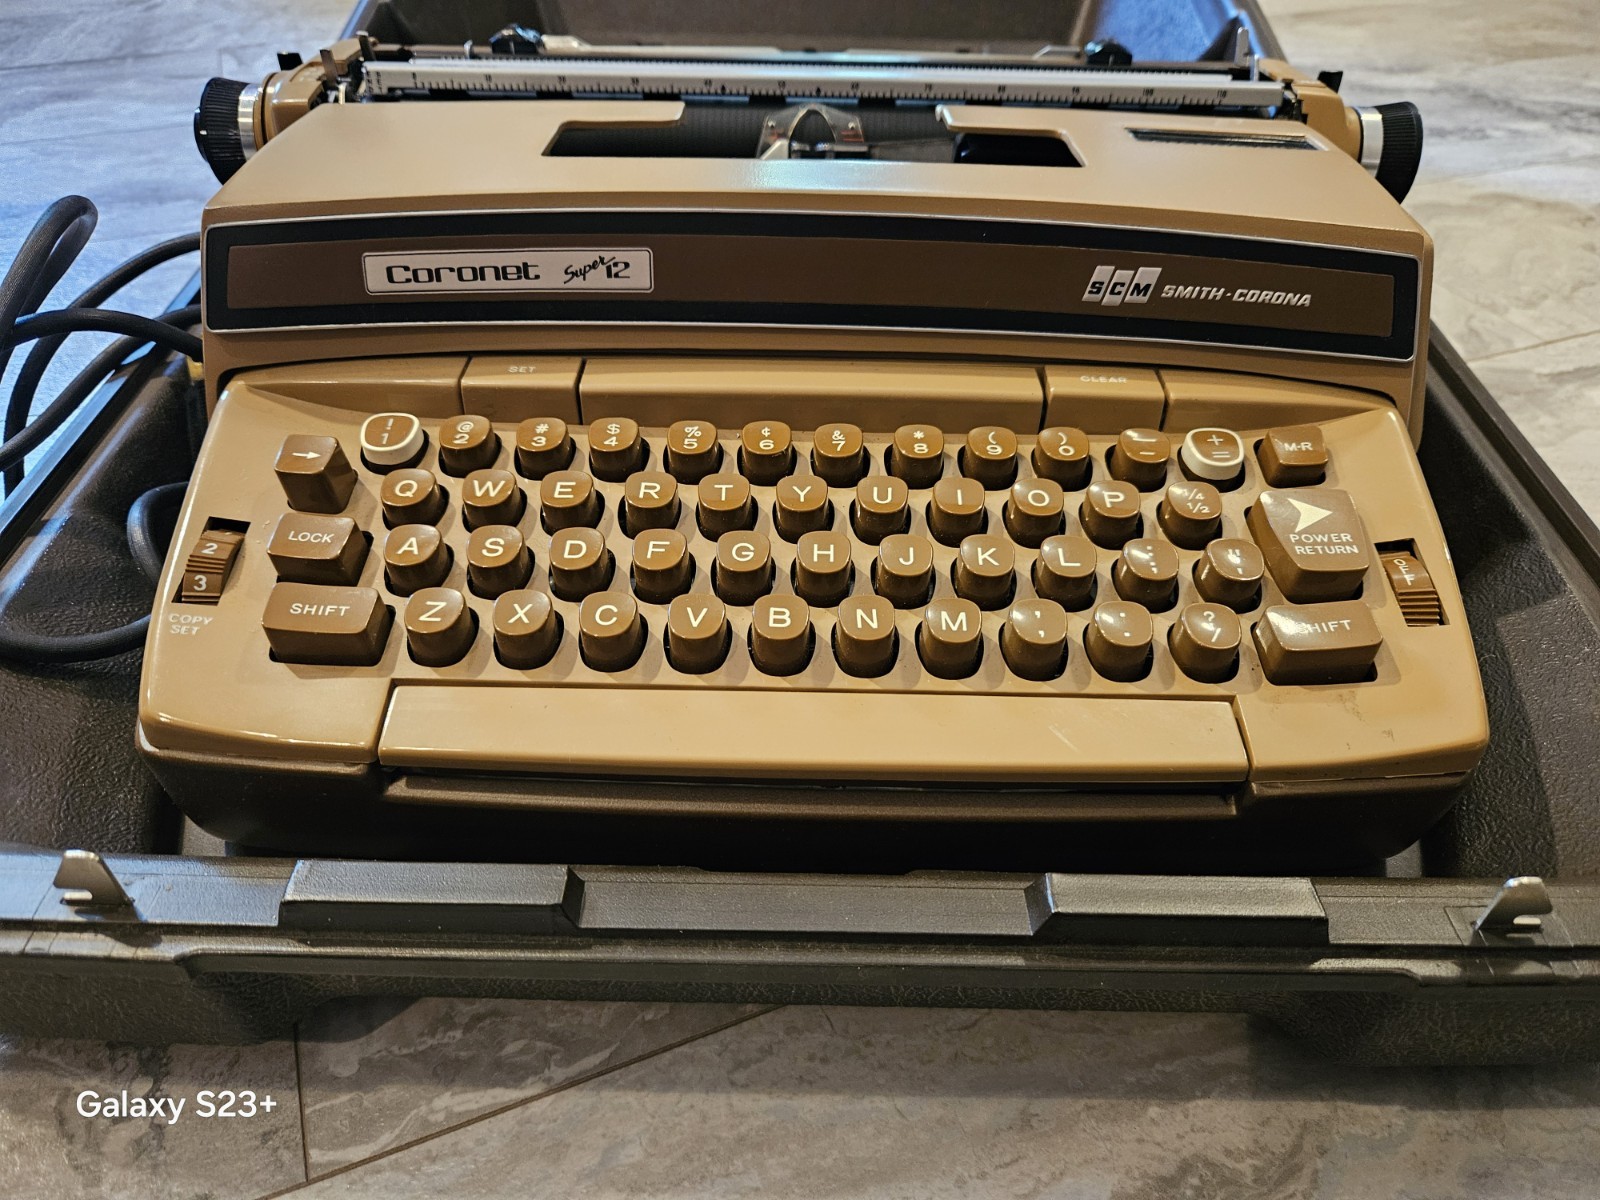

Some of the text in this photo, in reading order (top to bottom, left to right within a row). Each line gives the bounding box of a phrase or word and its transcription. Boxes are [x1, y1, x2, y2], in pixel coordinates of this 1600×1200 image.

[386, 255, 631, 284] Coronet Super 12
[1087, 281, 1152, 297] SCM
[508, 365, 536, 374] SET
[1080, 375, 1127, 384] CLEAR
[381, 433, 389, 444] 1
[453, 433, 470, 444] 2
[531, 436, 547, 447] 3
[603, 436, 619, 447] 4
[682, 438, 698, 450] 5
[759, 440, 775, 450] 6
[831, 441, 846, 452] 7
[913, 443, 929, 454] 8
[986, 445, 1002, 455] 9
[1058, 445, 1075, 456] 0
[394, 479, 418, 498] Q
[472, 480, 505, 497] W
[553, 481, 575, 498] E
[638, 482, 661, 499] R
[714, 484, 734, 501] T
[792, 485, 812, 503] Y
[872, 486, 893, 504] U
[1027, 489, 1050, 507] O
[1102, 490, 1125, 508] P
[288, 530, 334, 544] LOCK
[1289, 533, 1353, 545] POWER
[201, 542, 218, 554] 2
[397, 537, 420, 555] A
[481, 537, 505, 557] S
[562, 540, 588, 559] D
[646, 541, 671, 558] F
[731, 542, 755, 562] G
[812, 543, 835, 563] H
[1295, 545, 1359, 555] RETURN
[898, 547, 915, 566] J
[977, 547, 1000, 566] K
[1057, 547, 1082, 567] L
[1393, 558, 1415, 586] OFF
[193, 575, 207, 591] 3
[289, 603, 350, 617] SHIFT
[418, 602, 447, 622] Z
[507, 604, 533, 624] X
[594, 605, 618, 626] C
[686, 607, 708, 627] V
[768, 607, 791, 628] B
[169, 613, 213, 625] COPY
[856, 609, 878, 629] N
[940, 611, 967, 631] M
[170, 624, 200, 635] SET
